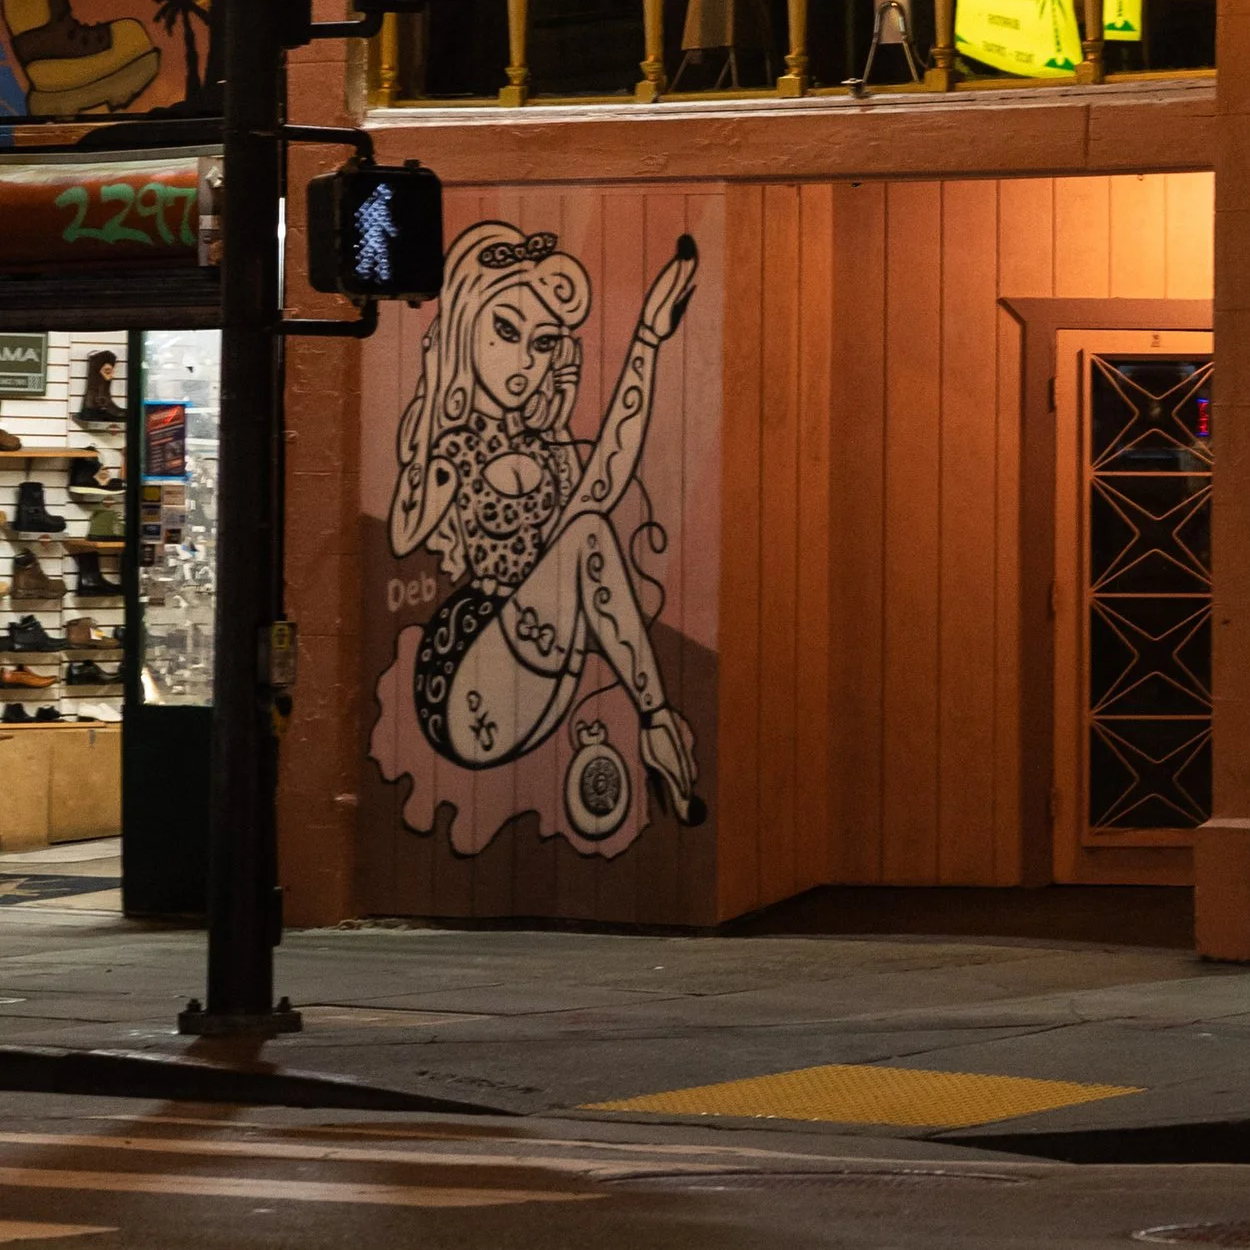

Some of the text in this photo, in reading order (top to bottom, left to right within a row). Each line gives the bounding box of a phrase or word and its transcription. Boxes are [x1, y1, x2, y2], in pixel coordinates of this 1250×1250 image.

[55, 182, 197, 245] 2297
[0, 347, 40, 362] MA
[387, 571, 437, 612] Deb
